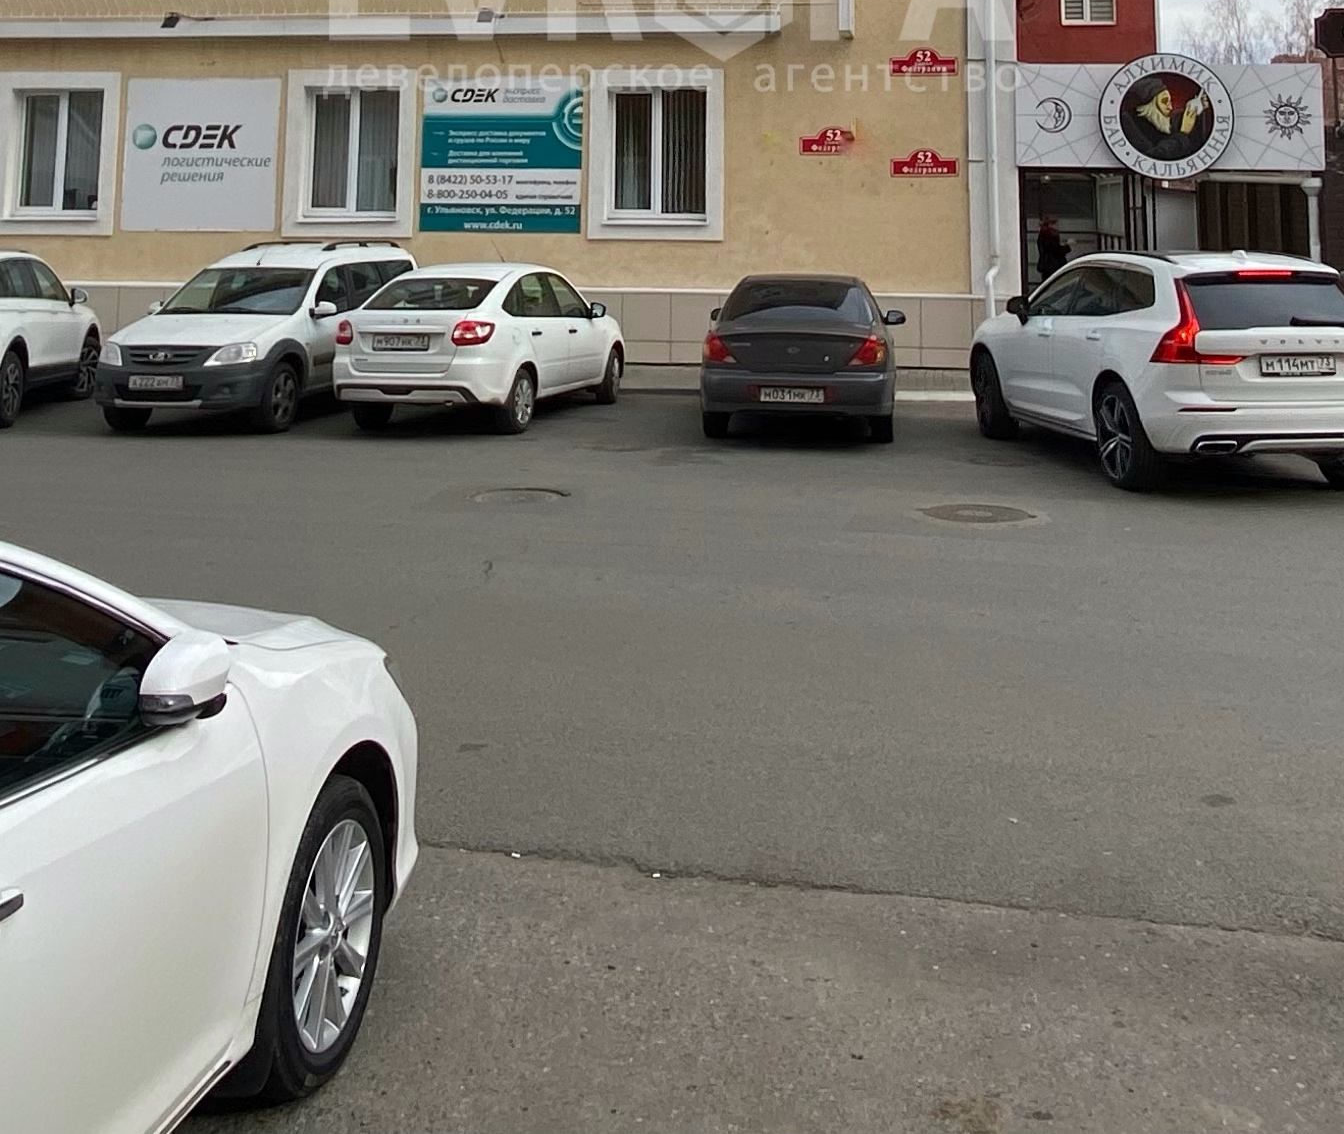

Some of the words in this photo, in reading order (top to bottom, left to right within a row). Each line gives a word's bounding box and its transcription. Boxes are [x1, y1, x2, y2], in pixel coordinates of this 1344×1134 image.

[915, 51, 932, 62] 52
[1112, 56, 1218, 95] АЛХИМИК
[450, 87, 500, 103] CDEK
[161, 124, 244, 150] CDEK
[825, 130, 842, 141] 52
[1102, 115, 1127, 148] БАР
[1132, 115, 1231, 176] КАЛЬЯННАЯ
[161, 156, 272, 168] логистические
[916, 151, 933, 163] 52
[159, 171, 225, 185] решения
[427, 175, 434, 185] 8
[436, 174, 468, 185] (8422)
[469, 174, 514, 185] 50-53-17
[426, 189, 509, 200] 8-800-250-04-05
[564, 206, 576, 215] 52
